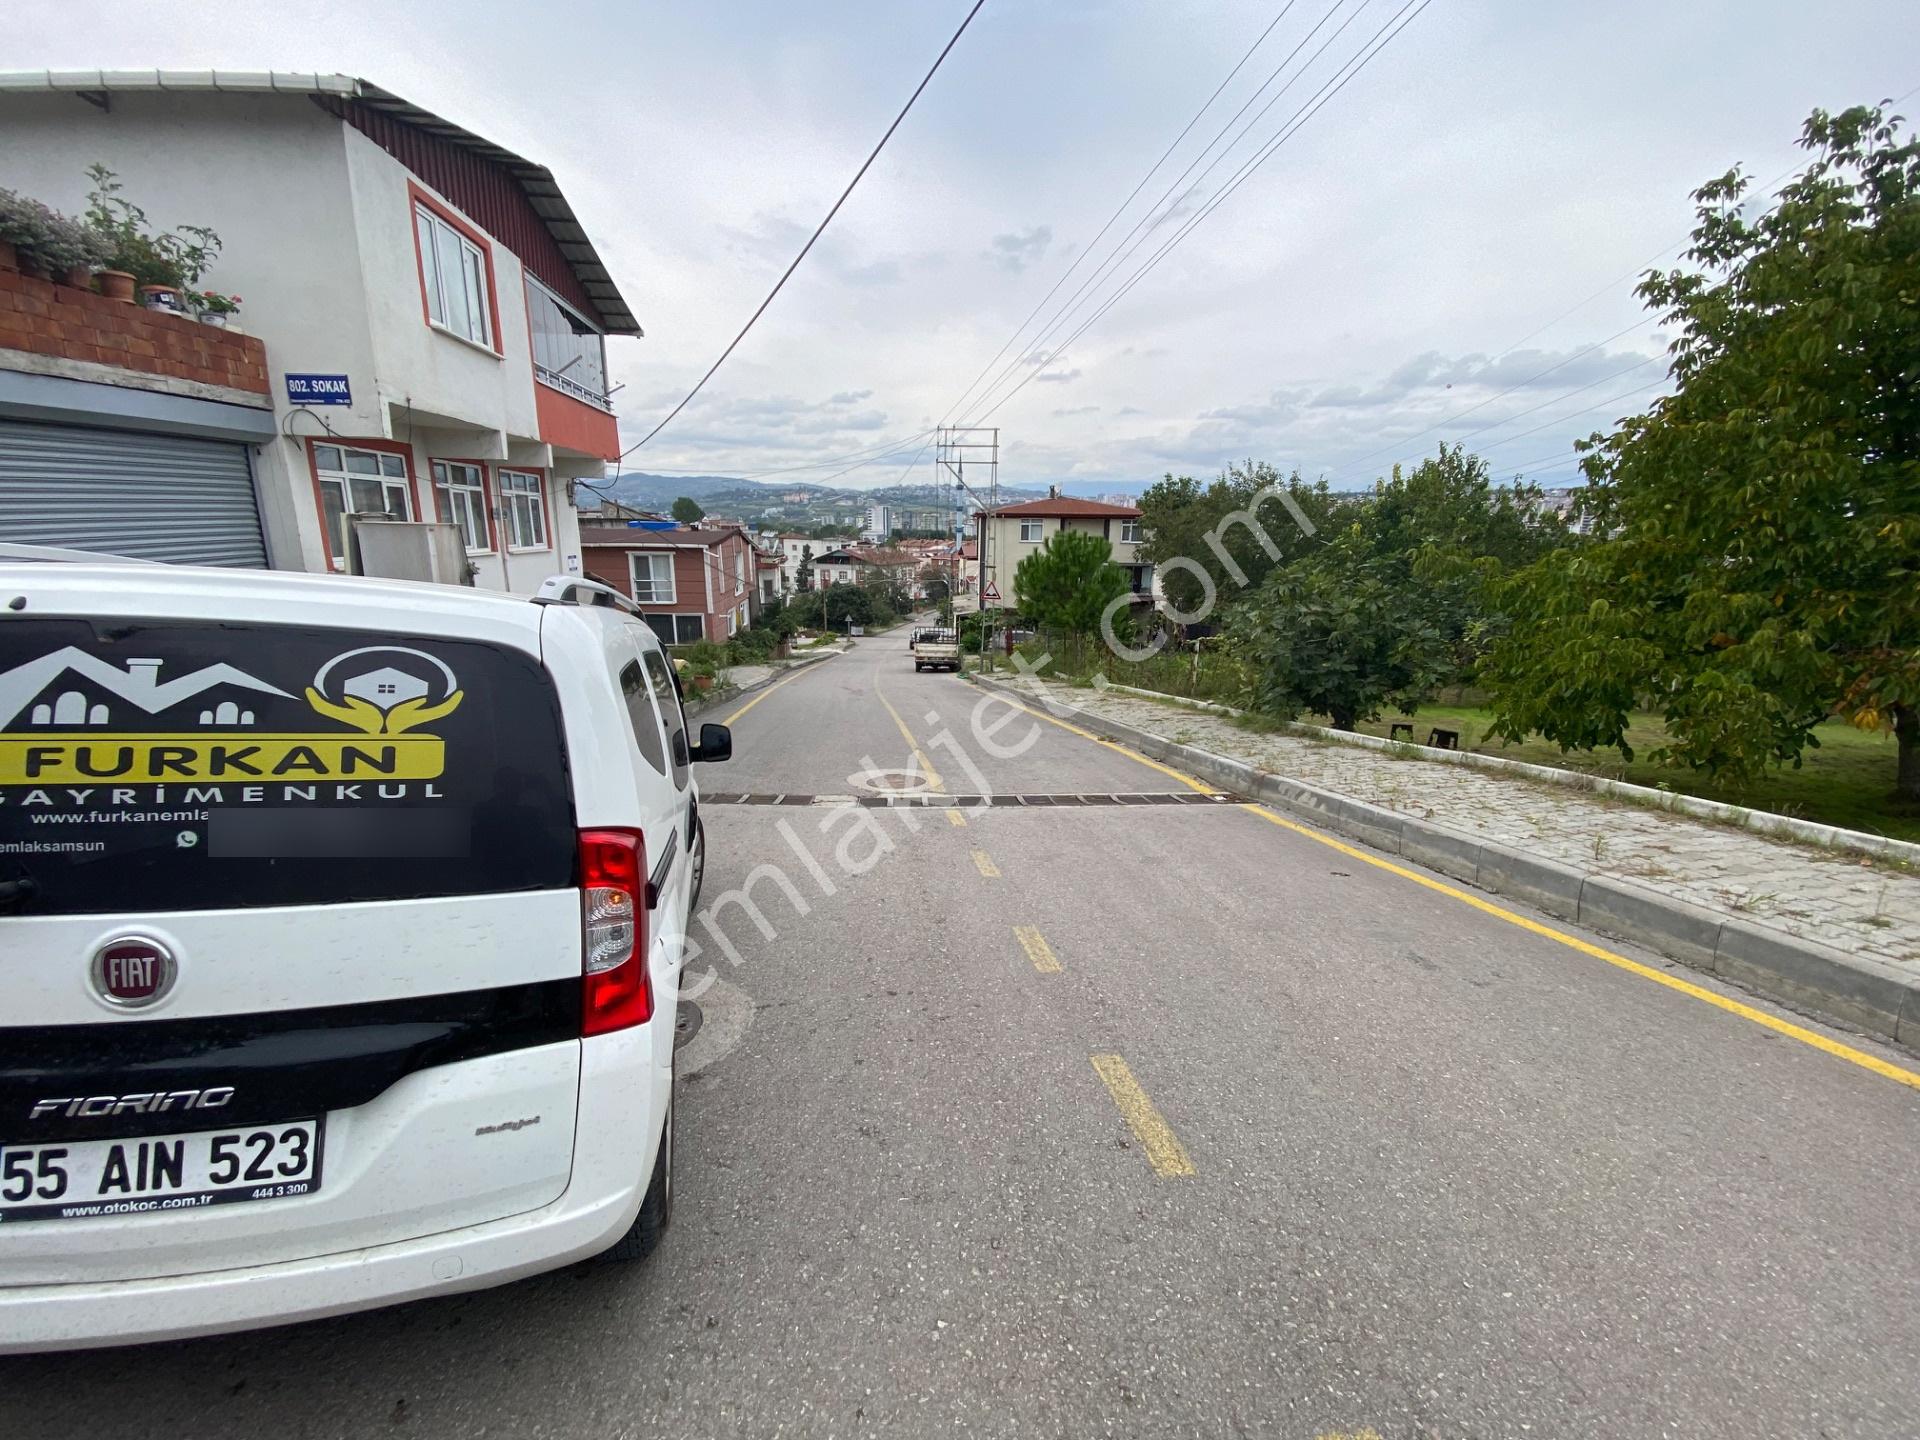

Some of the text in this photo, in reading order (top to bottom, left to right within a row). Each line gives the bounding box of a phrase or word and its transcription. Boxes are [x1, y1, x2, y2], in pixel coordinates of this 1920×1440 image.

[288, 379, 348, 393] 802. SOKAK
[26, 746, 396, 777] FURKAN
[0, 784, 443, 805] AYRİMENKUL
[110, 957, 156, 988] FIAT
[29, 1087, 235, 1119] FIORINO
[2, 1128, 309, 1201] 55 AIN 523
[252, 1183, 308, 1198] 444 3 300
[62, 1194, 213, 1217] www.otokoc.com.tr
